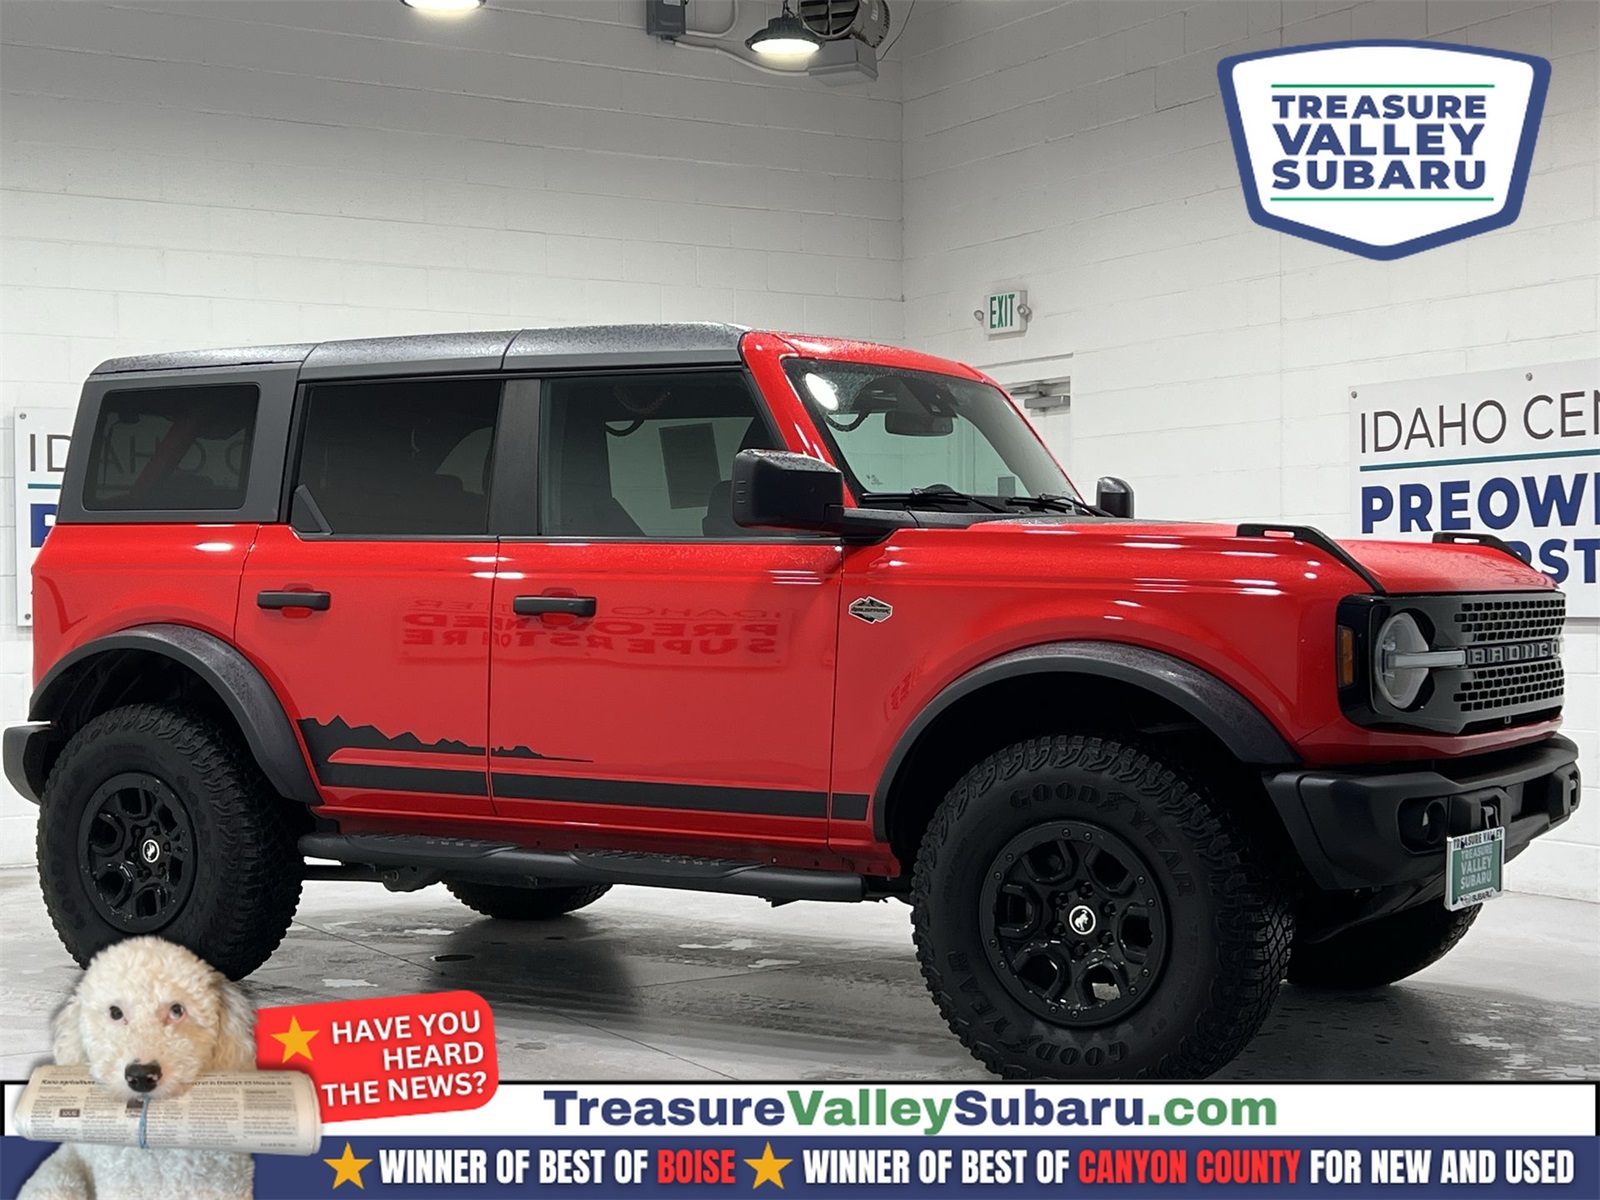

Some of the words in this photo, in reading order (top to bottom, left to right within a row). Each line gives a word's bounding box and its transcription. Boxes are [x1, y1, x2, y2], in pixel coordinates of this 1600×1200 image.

[989, 293, 1015, 329] EXIT
[1361, 399, 1507, 454] IDAHO
[1523, 390, 1600, 440] CE
[1361, 472, 1600, 535] PREOW
[1467, 638, 1560, 666] BRONCO
[1461, 844, 1493, 860] TREASURE
[1461, 855, 1493, 875] VALLEY
[1460, 870, 1493, 890] SUBARU
